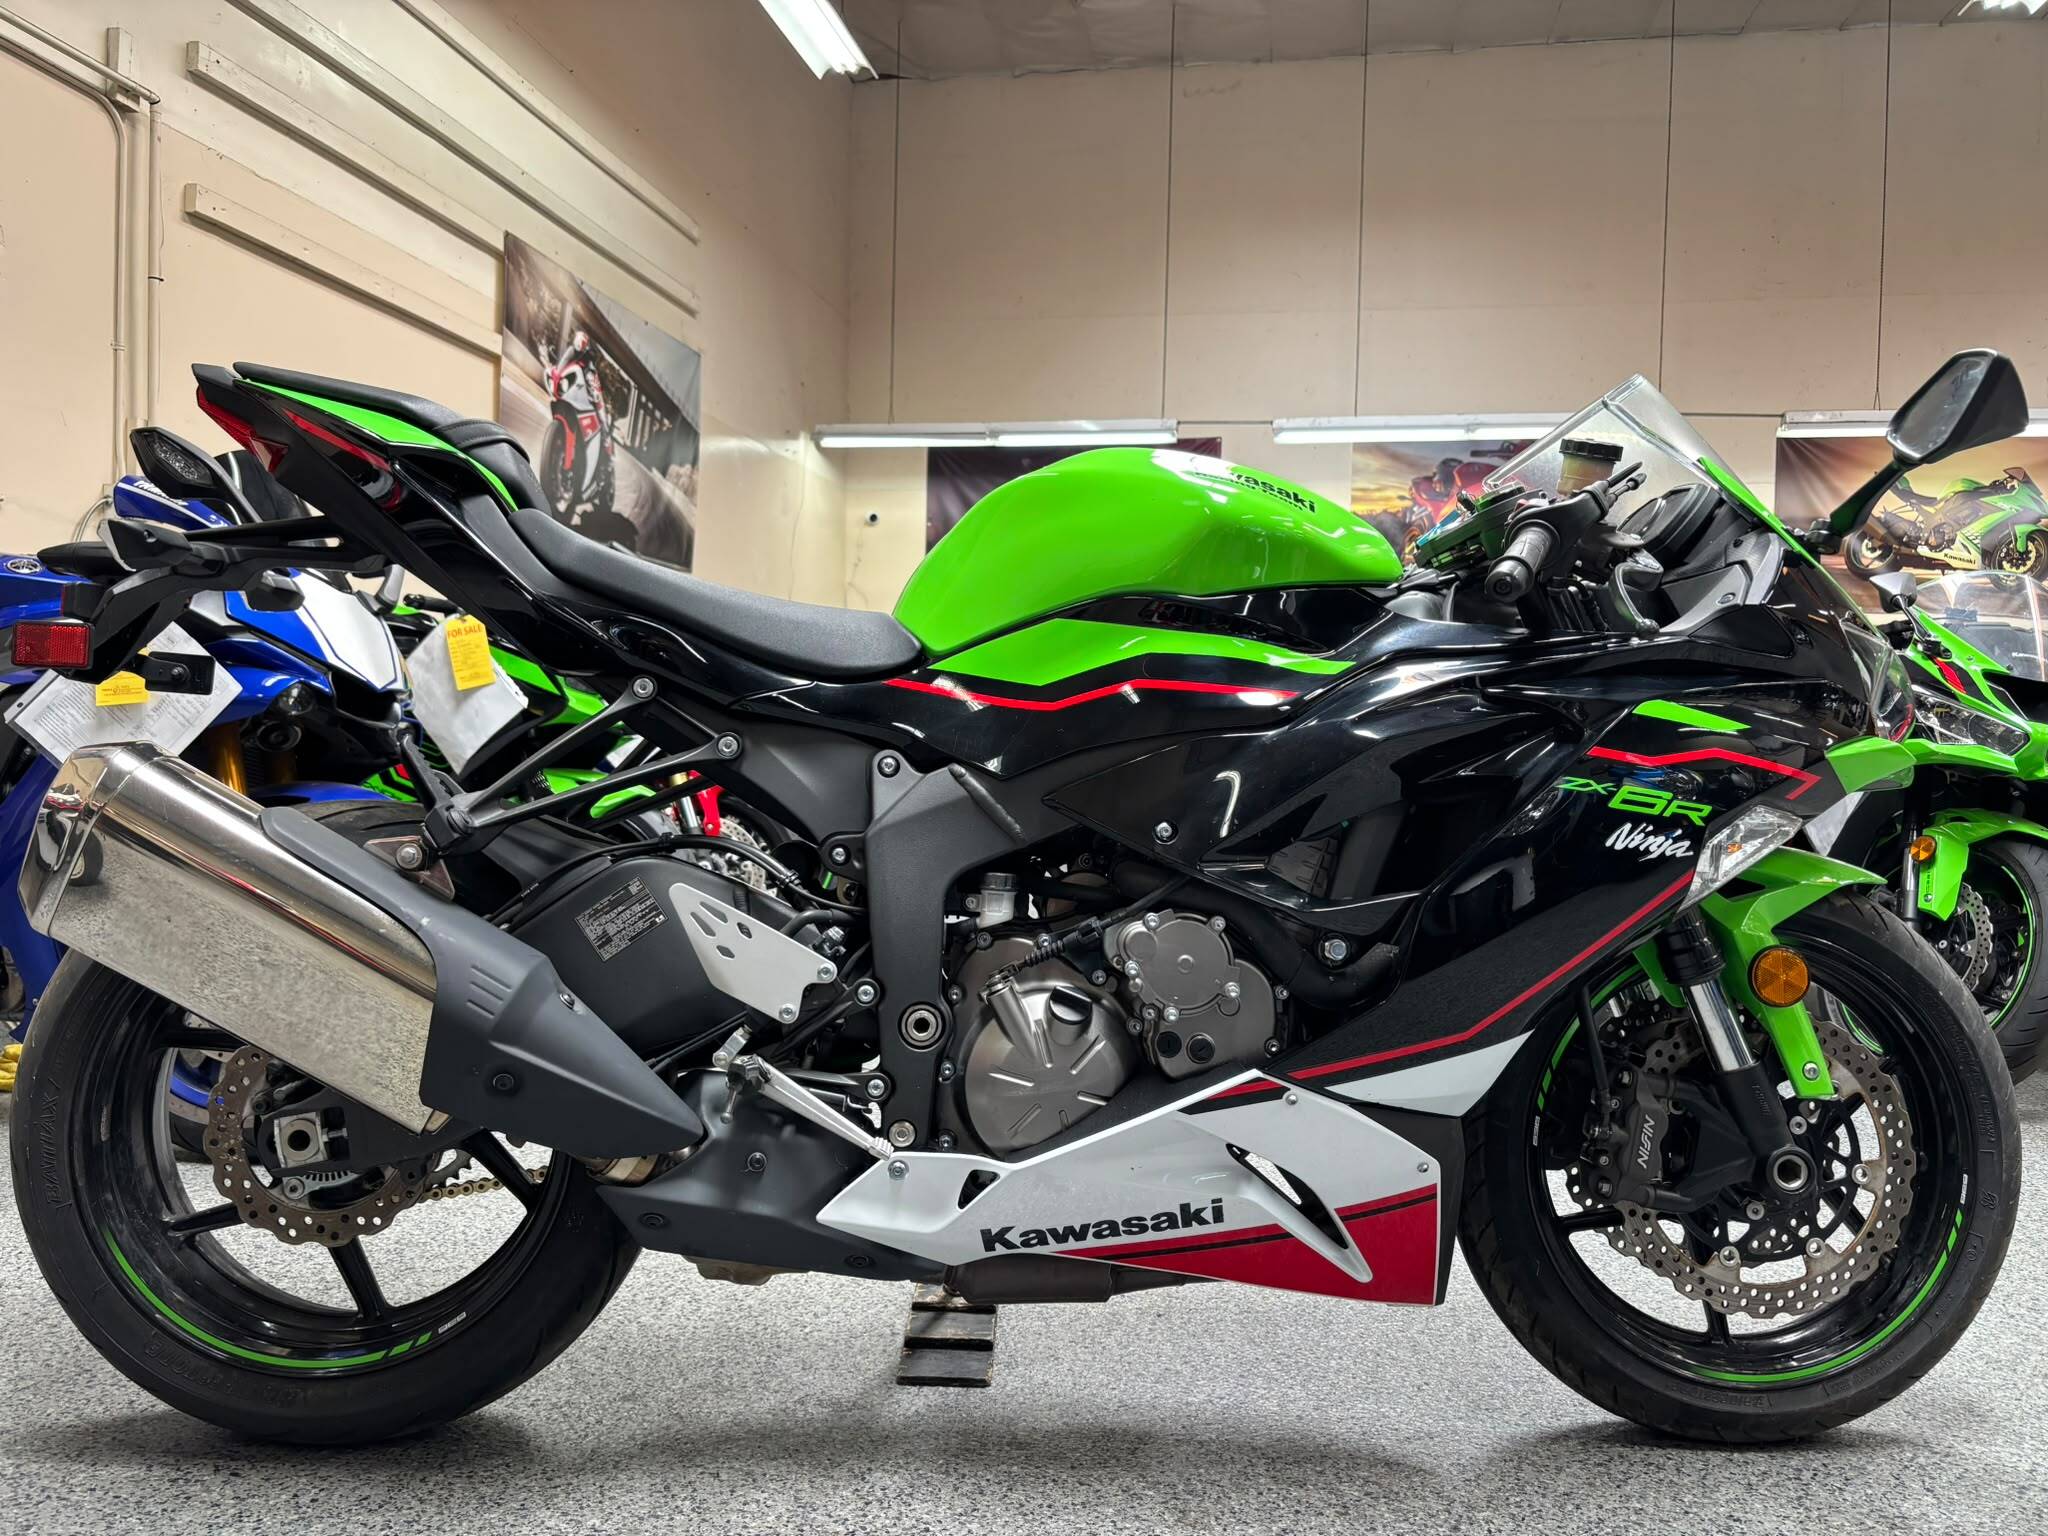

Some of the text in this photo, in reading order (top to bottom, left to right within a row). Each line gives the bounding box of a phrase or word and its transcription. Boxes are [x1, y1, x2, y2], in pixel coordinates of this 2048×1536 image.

[447, 627, 463, 638] FOR
[1605, 822, 1694, 862] Ninja
[979, 1197, 1225, 1253] Kawasaki
